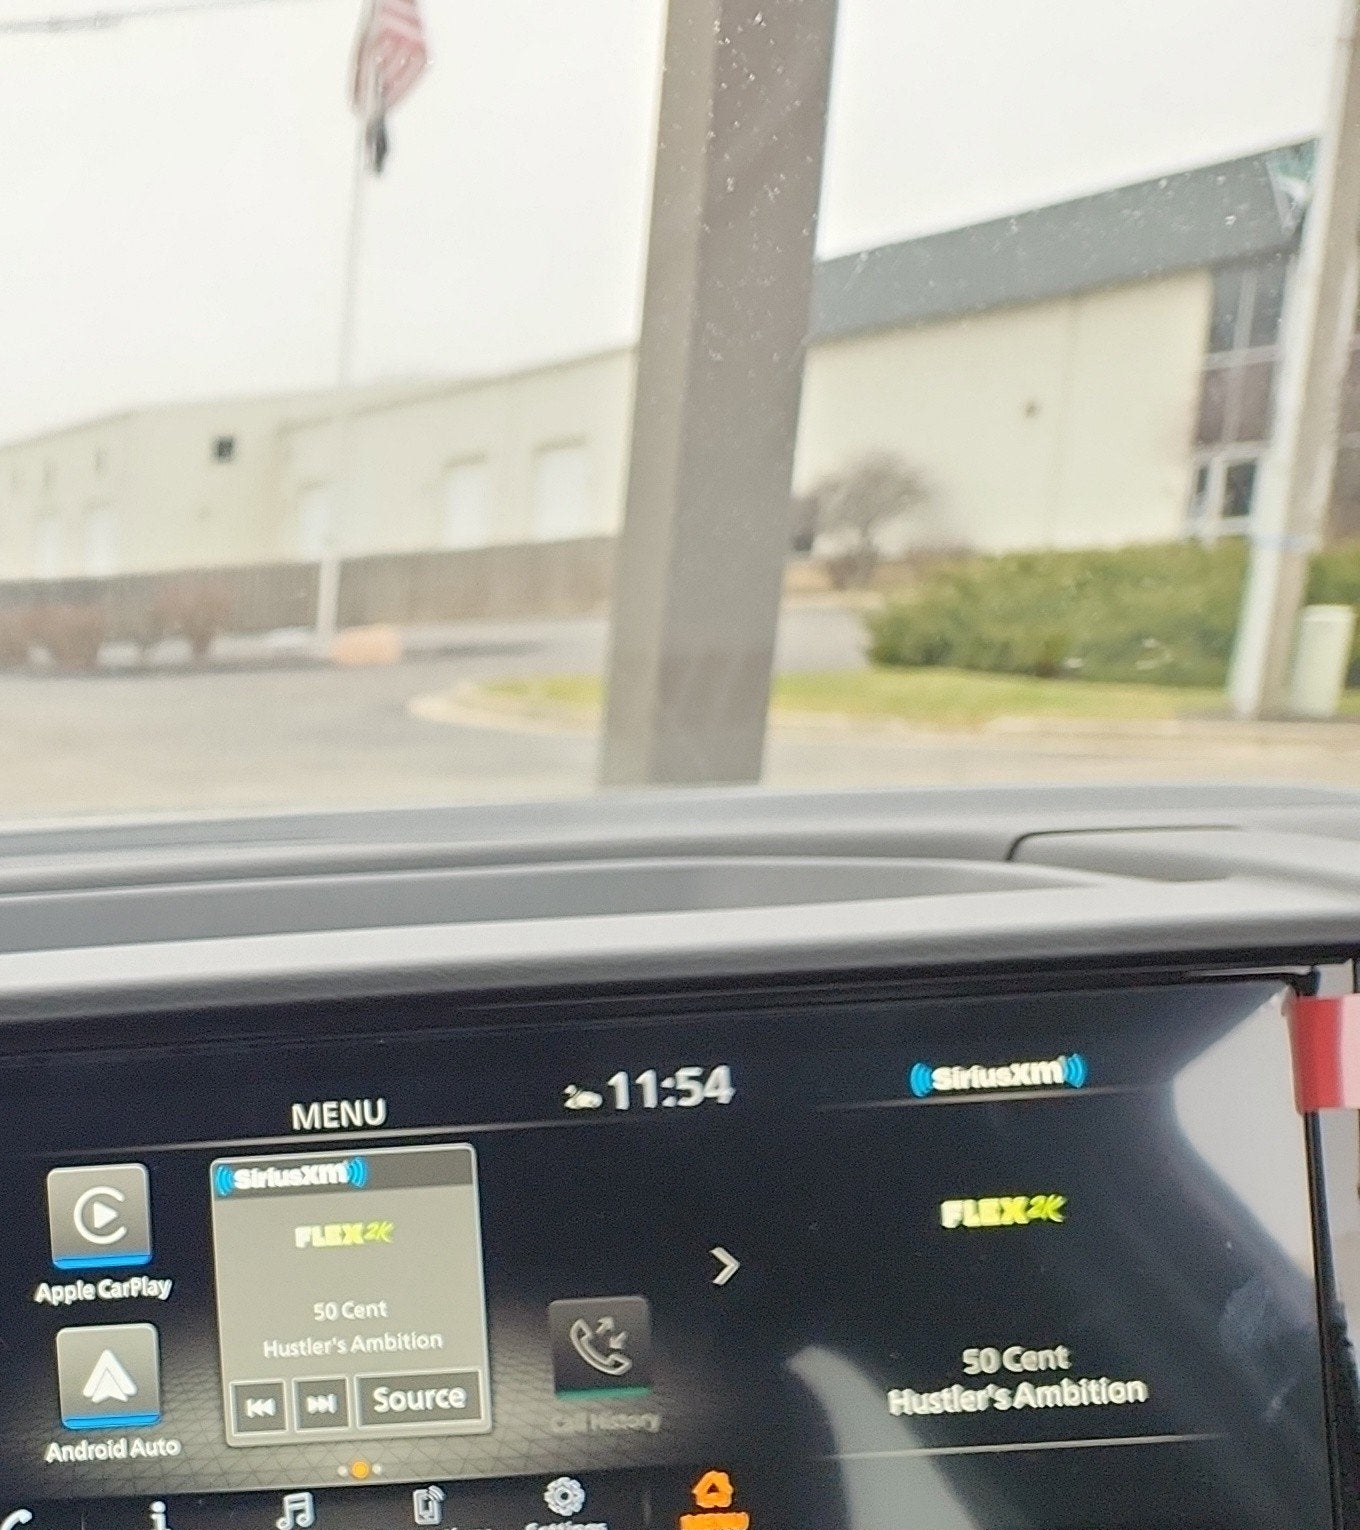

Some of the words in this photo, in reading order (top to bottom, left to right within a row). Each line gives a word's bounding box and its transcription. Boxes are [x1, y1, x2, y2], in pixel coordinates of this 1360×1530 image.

[608, 1065, 734, 1109] 11:54
[292, 1099, 386, 1130] MENU
[34, 1281, 95, 1305] Apple
[97, 1276, 172, 1300] CarPlay
[314, 1301, 341, 1321] 50
[345, 1299, 388, 1319] Cent
[263, 1334, 345, 1358] Hustler's
[350, 1330, 443, 1353] Ambition
[963, 1350, 998, 1375] 50
[1002, 1345, 1071, 1371] Cent
[374, 1385, 465, 1412] Source
[889, 1386, 1011, 1416] Hustler's
[1012, 1377, 1148, 1408] Ambition
[45, 1437, 126, 1463] Android
[130, 1436, 181, 1458] Auto
